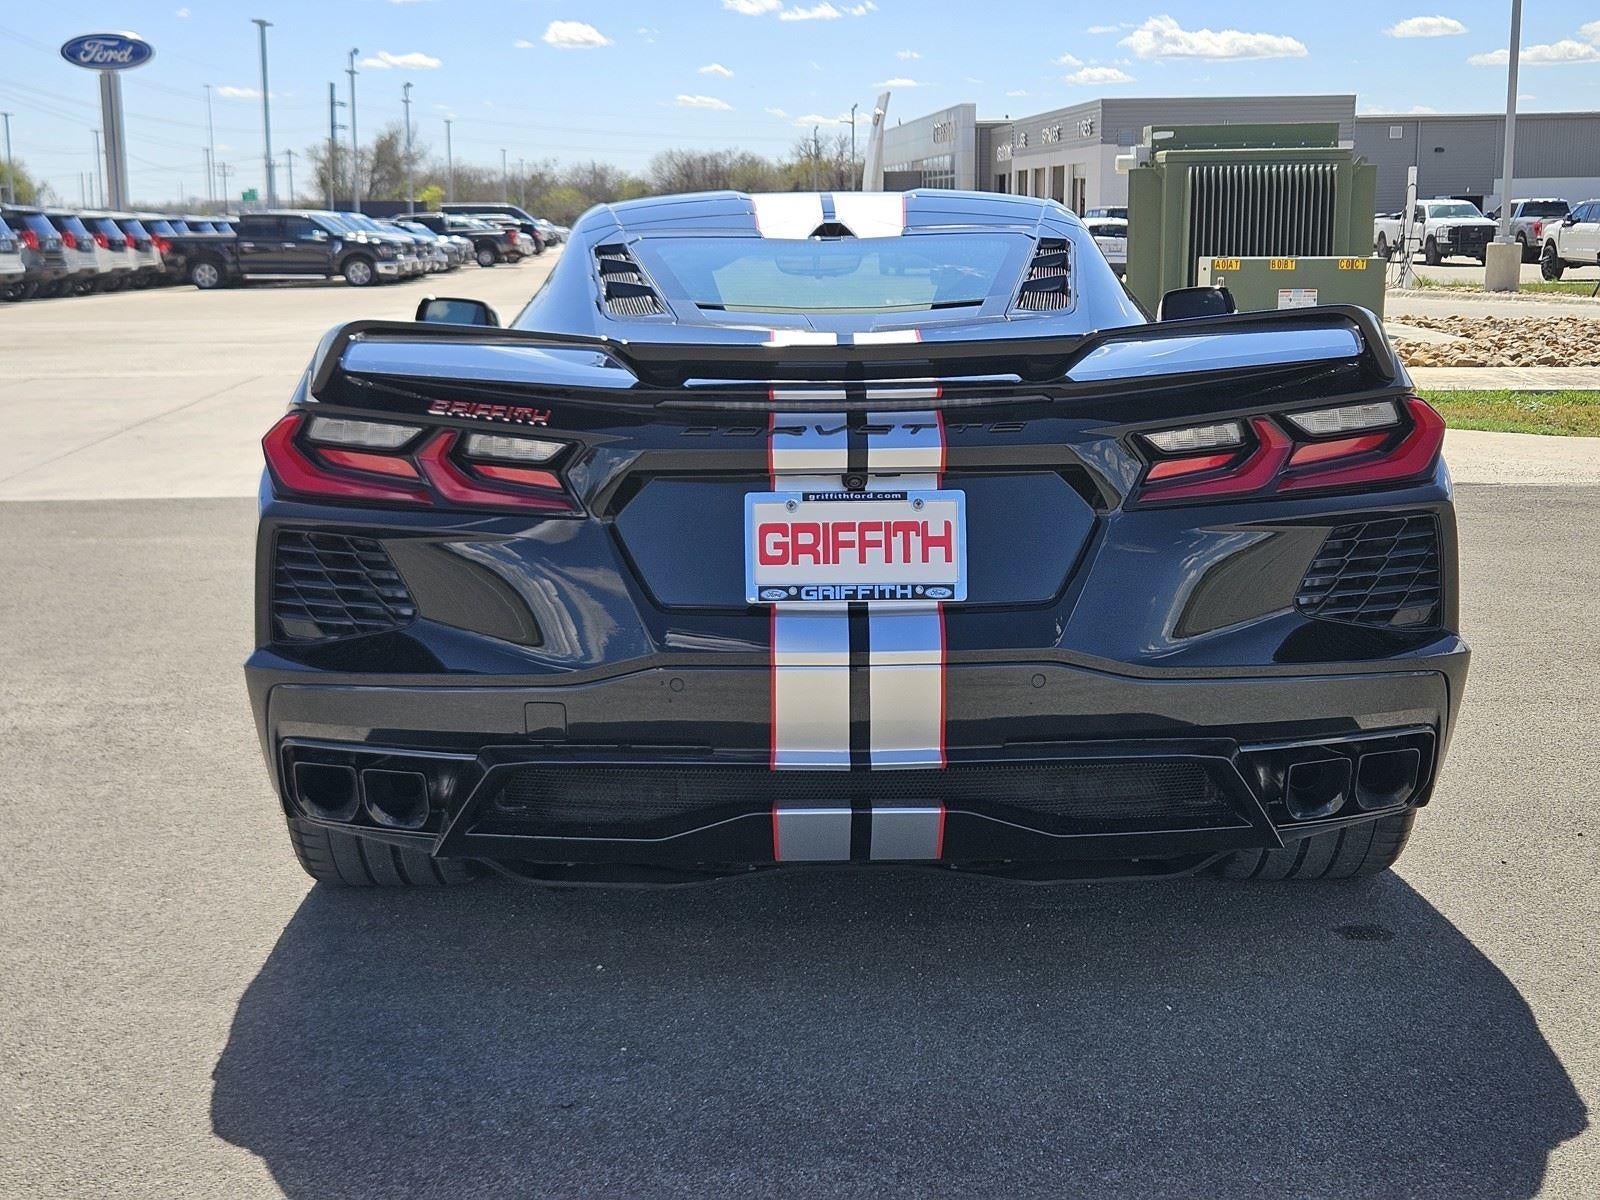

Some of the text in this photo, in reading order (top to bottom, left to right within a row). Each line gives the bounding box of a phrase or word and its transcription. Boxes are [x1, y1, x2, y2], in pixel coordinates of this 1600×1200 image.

[80, 38, 134, 64] Ford
[679, 421, 1030, 438] CORVETTE
[808, 492, 902, 501] griffithford.com
[758, 520, 953, 566] GRIFFITH
[800, 585, 912, 600] GRIFFITH
